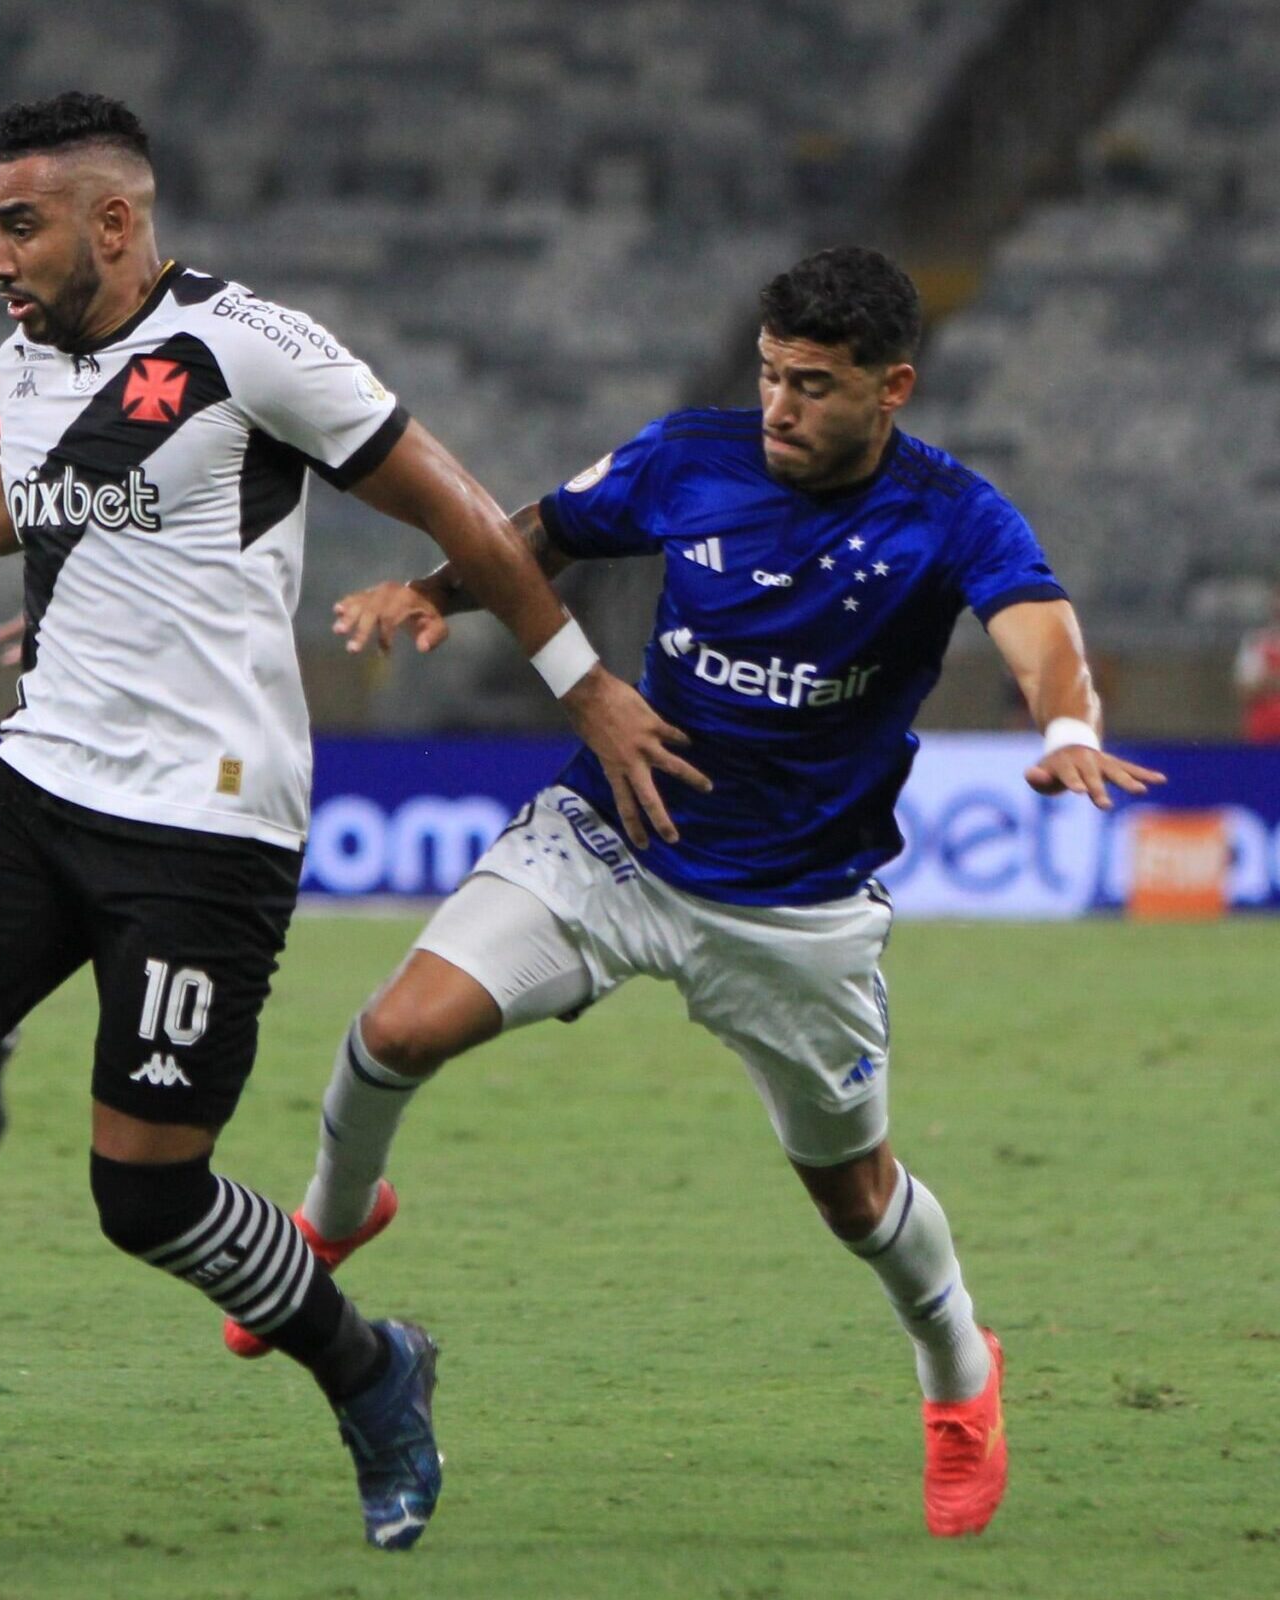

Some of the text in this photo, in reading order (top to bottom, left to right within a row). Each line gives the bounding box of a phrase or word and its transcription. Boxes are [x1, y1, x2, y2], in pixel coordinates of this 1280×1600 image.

[213, 296, 302, 360] Bitcoin
[8, 465, 159, 533] pixbet
[695, 643, 881, 708] betfair
[138, 958, 213, 1046] 10
